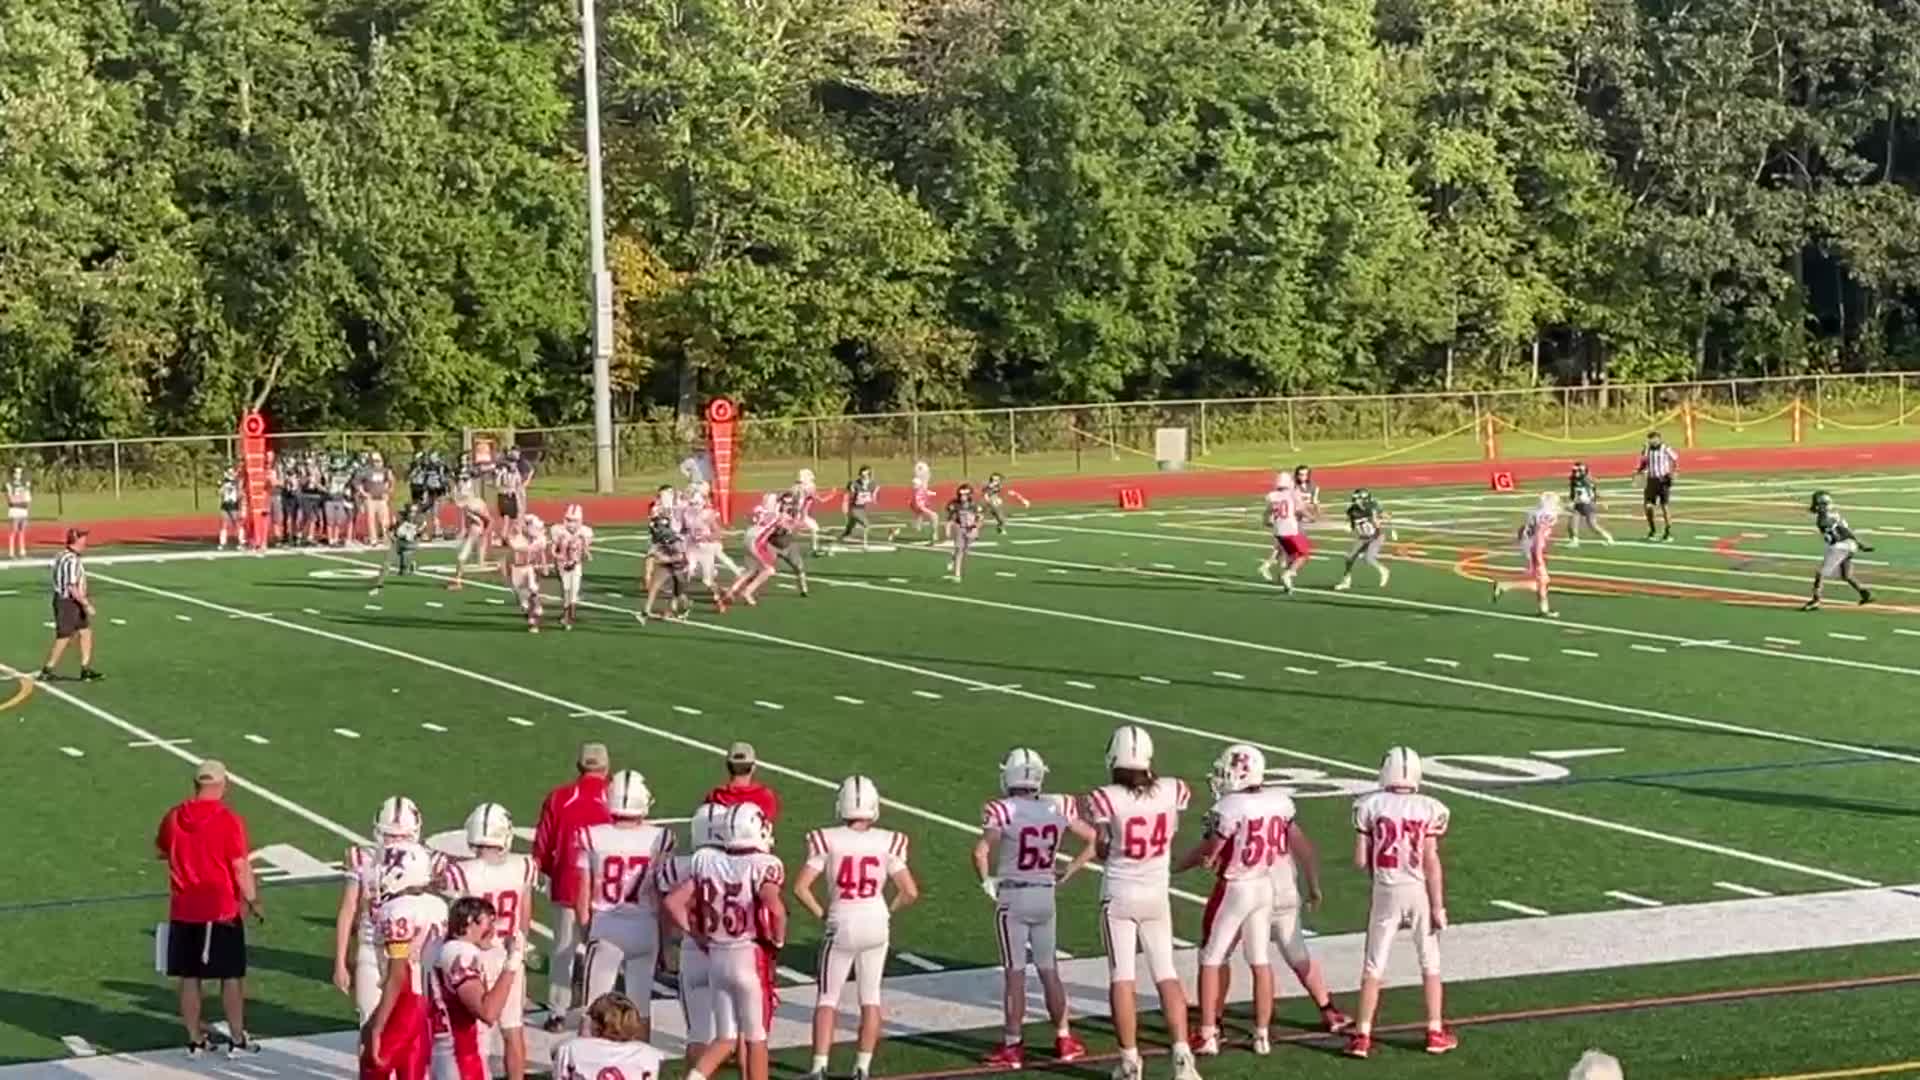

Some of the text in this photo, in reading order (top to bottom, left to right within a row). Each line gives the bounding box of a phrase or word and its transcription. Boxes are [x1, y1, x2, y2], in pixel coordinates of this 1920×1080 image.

[1498, 474, 1511, 488] G
[1017, 823, 1058, 871] 63
[1123, 803, 1167, 860] 64
[1376, 815, 1424, 869] 27
[602, 855, 651, 904] 87
[836, 855, 880, 900] 46
